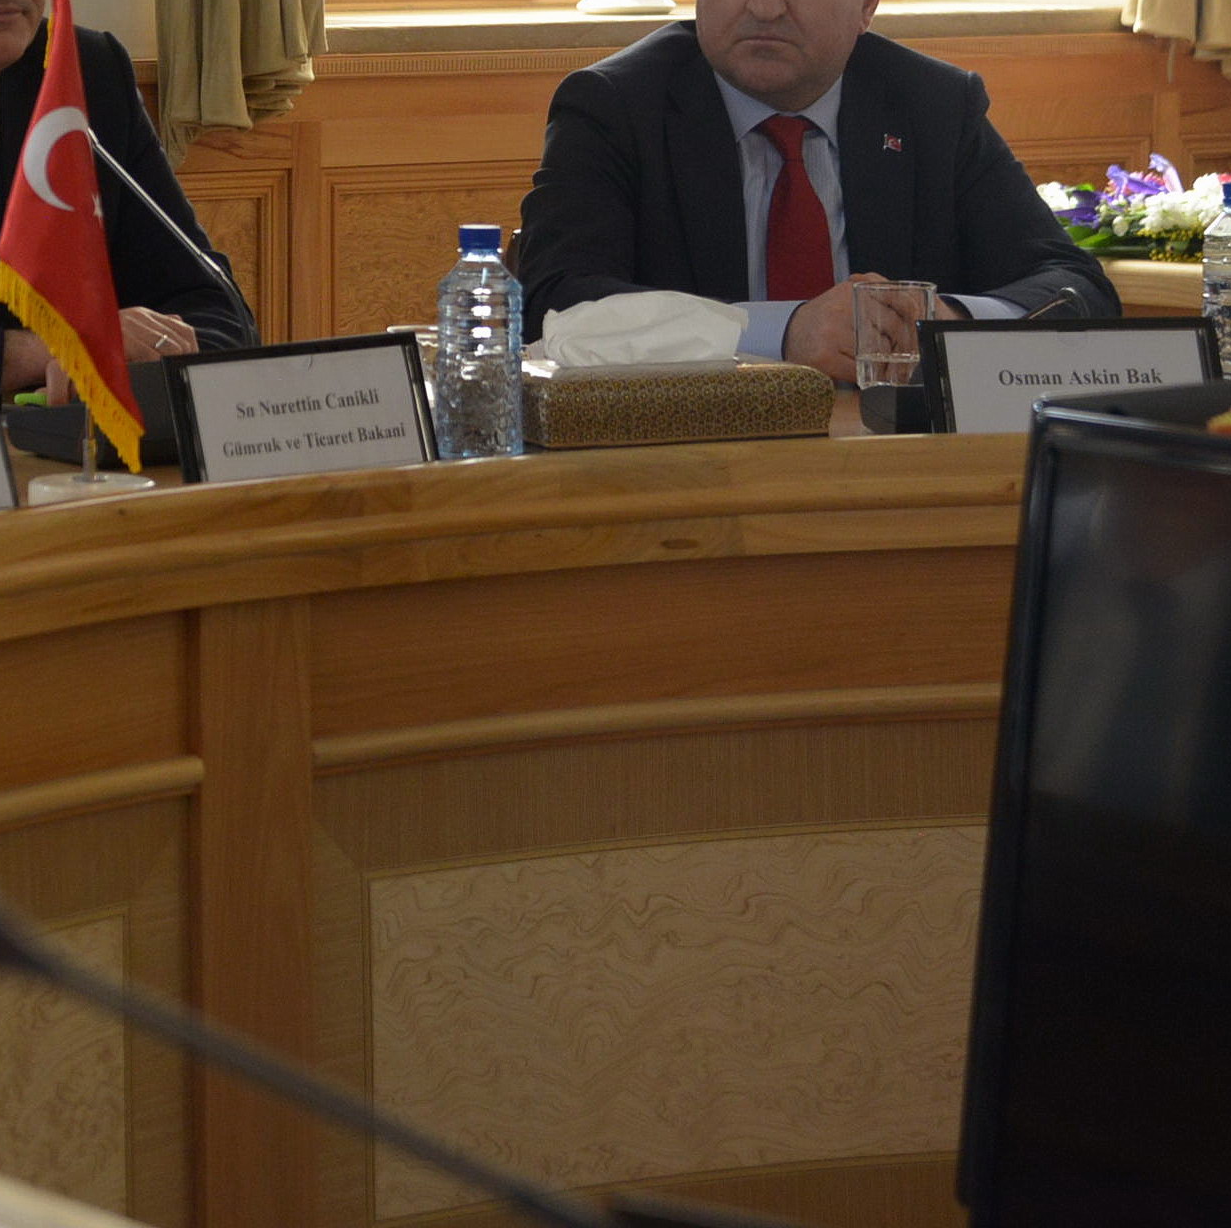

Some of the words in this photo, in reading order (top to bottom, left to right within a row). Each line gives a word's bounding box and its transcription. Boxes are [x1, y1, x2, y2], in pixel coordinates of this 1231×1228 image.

[998, 369, 1063, 386] Osman
[1069, 369, 1120, 385] Askin
[1125, 368, 1163, 385] Bak
[235, 403, 255, 419] Sn
[259, 395, 322, 417] Nurettin
[325, 388, 380, 410] Canikli
[285, 439, 301, 450] ve
[303, 430, 354, 449] Ticaret
[357, 423, 407, 442] Bakani
